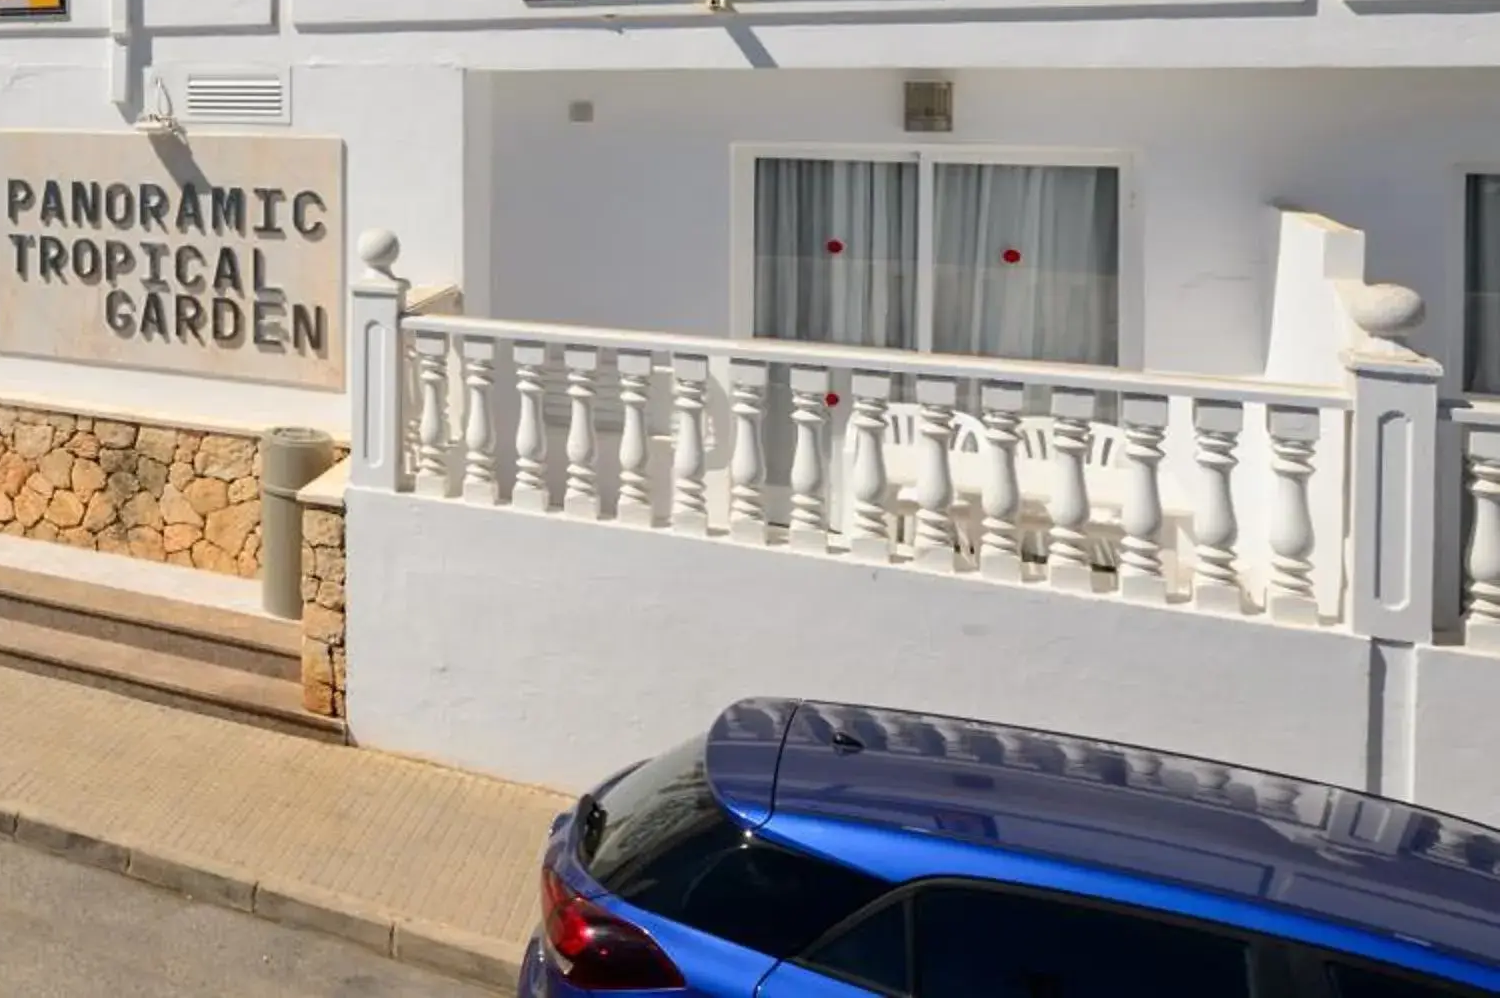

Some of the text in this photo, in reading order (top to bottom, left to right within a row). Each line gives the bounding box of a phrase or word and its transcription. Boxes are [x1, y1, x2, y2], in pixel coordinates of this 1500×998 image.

[7, 177, 328, 238] PANORAMIC
[7, 233, 286, 296] TROPICAL
[106, 289, 327, 353] GARDEN
